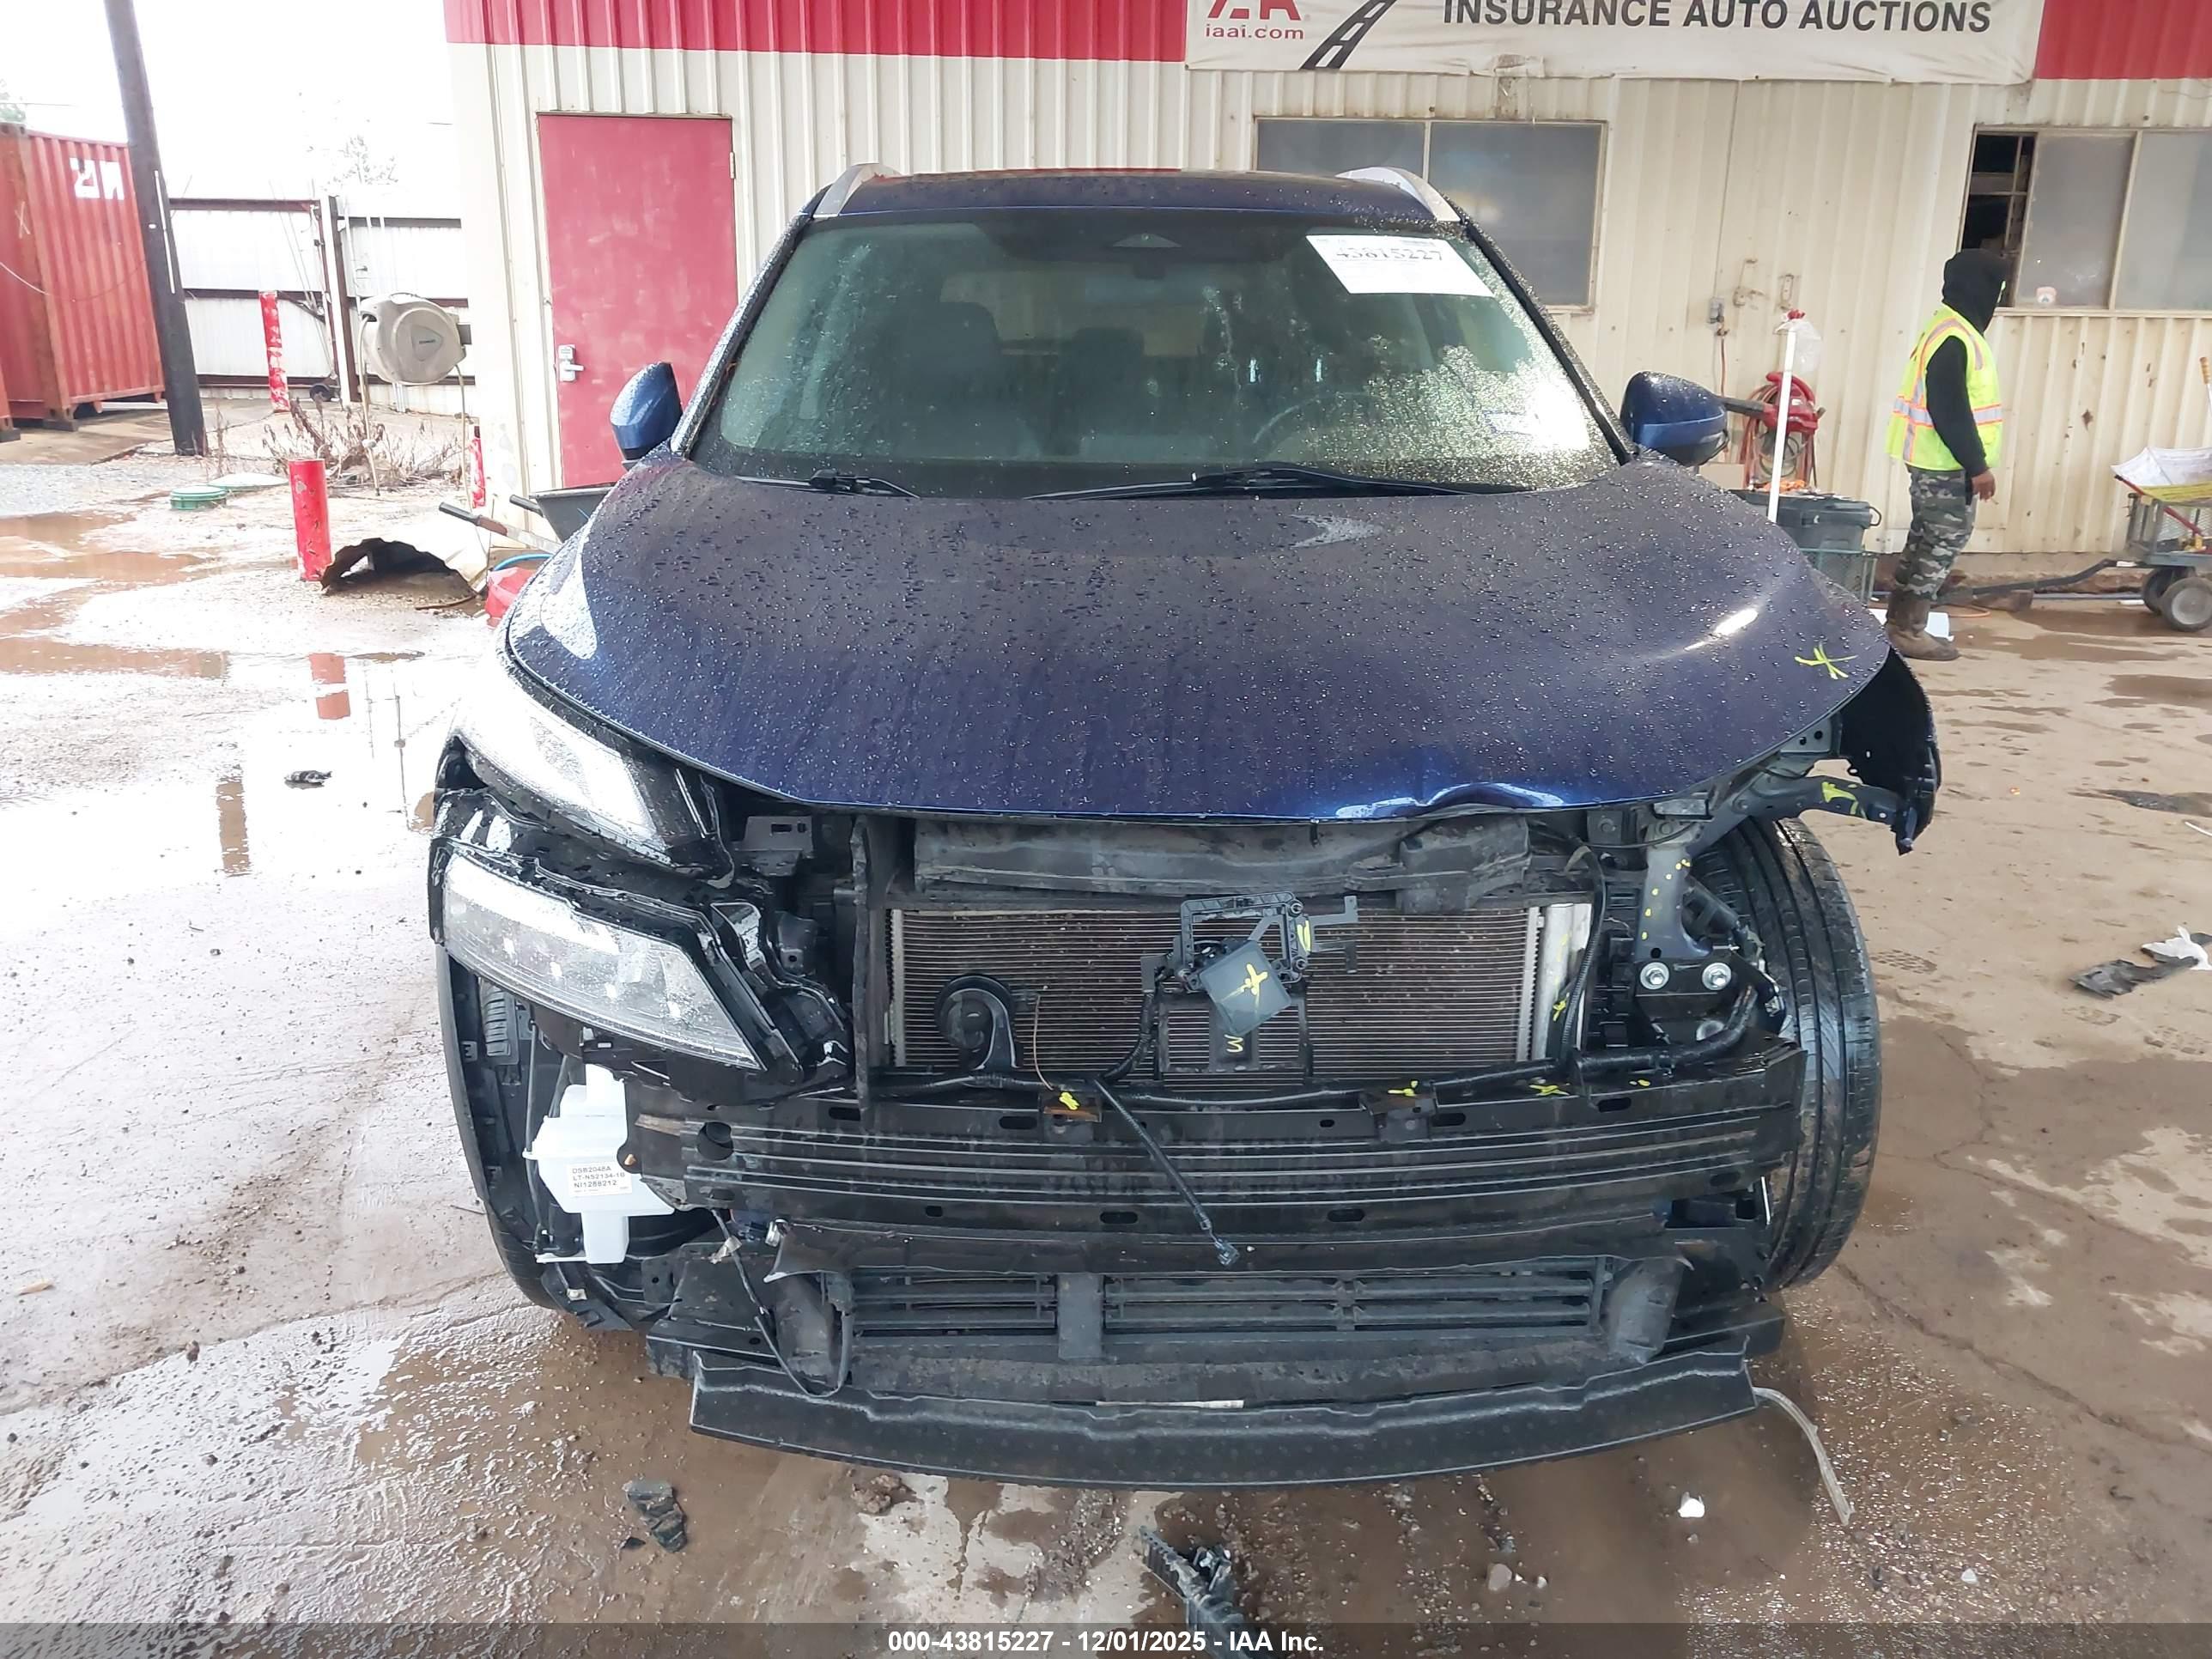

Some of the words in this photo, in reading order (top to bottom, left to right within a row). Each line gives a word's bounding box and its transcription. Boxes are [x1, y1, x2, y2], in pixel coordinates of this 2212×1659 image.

[1443, 0, 1670, 27] INSURANCE
[1683, 0, 1787, 29] AUTO
[1799, 0, 1991, 33] AUCTIONS
[1205, 24, 1304, 40] iaai.com
